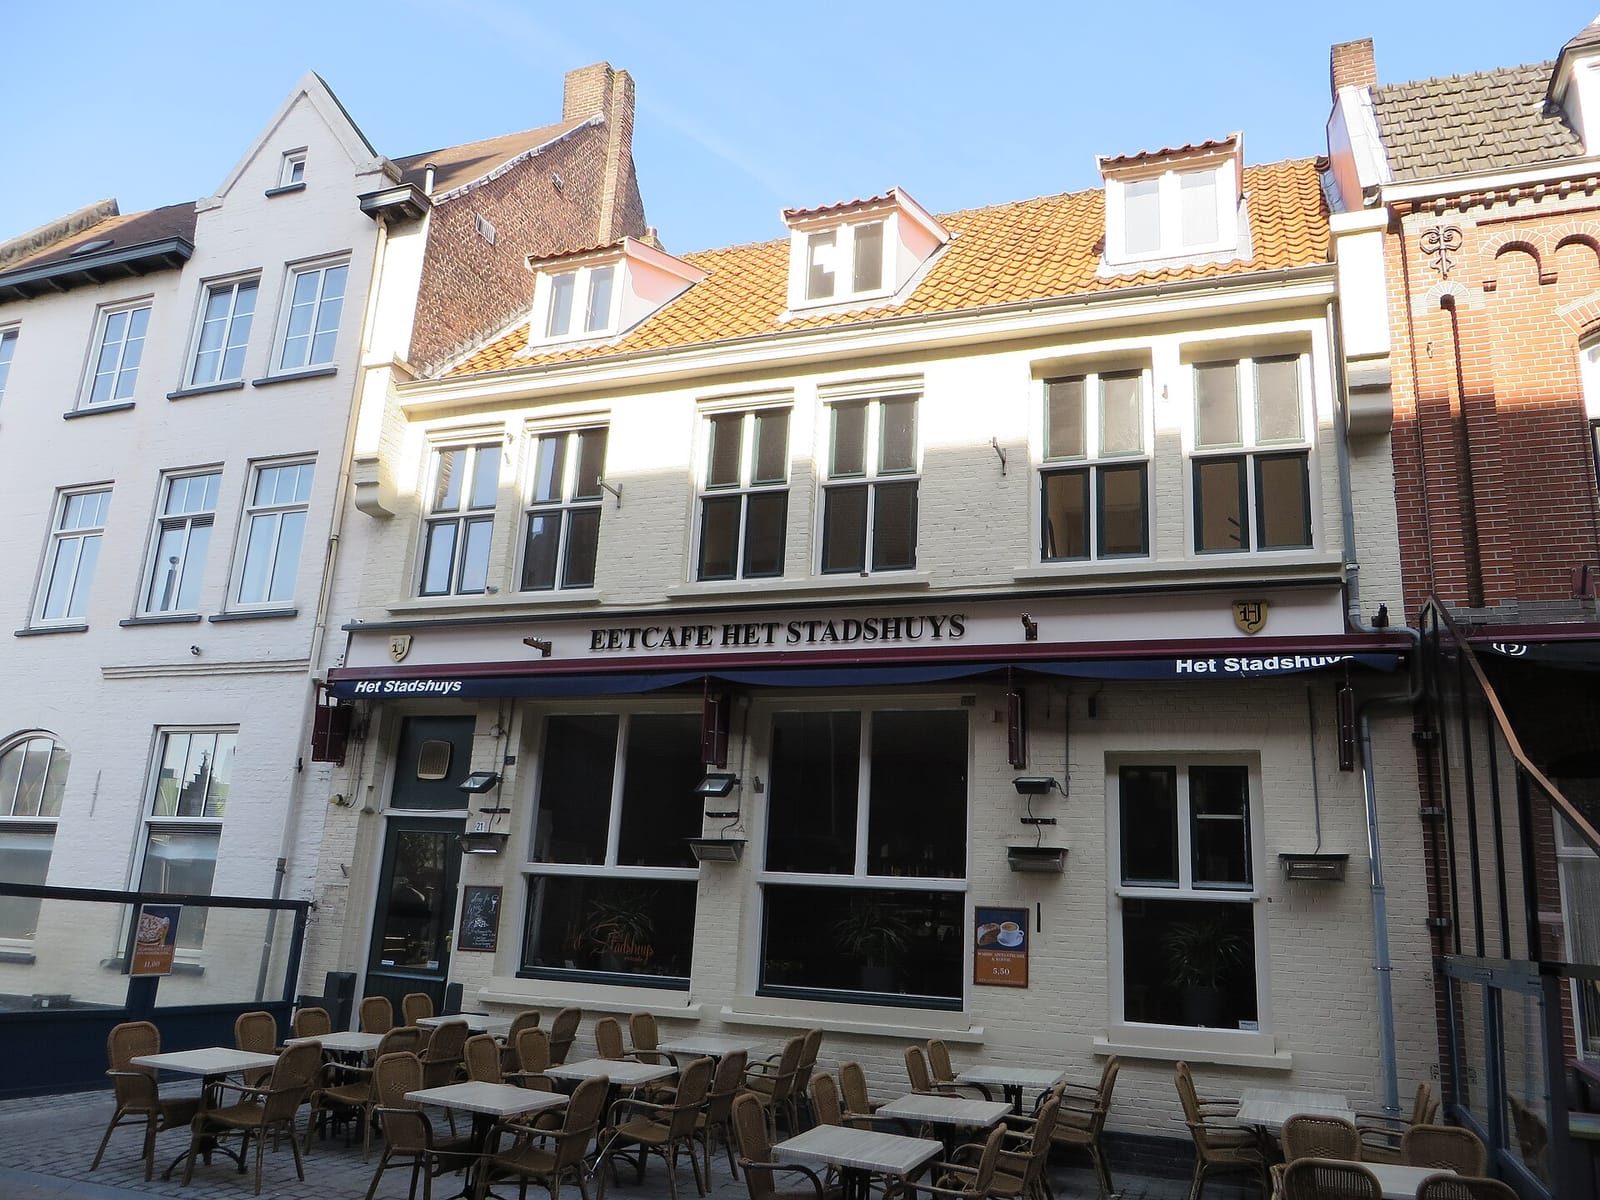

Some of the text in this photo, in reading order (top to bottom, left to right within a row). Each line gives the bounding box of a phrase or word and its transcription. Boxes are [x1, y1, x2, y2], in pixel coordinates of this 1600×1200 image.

[589, 614, 967, 650] EETCAFE HET STADSHUYS
[1176, 658, 1217, 673] Het
[354, 679, 463, 695] Het Stadshuys
[476, 822, 484, 831] 21
